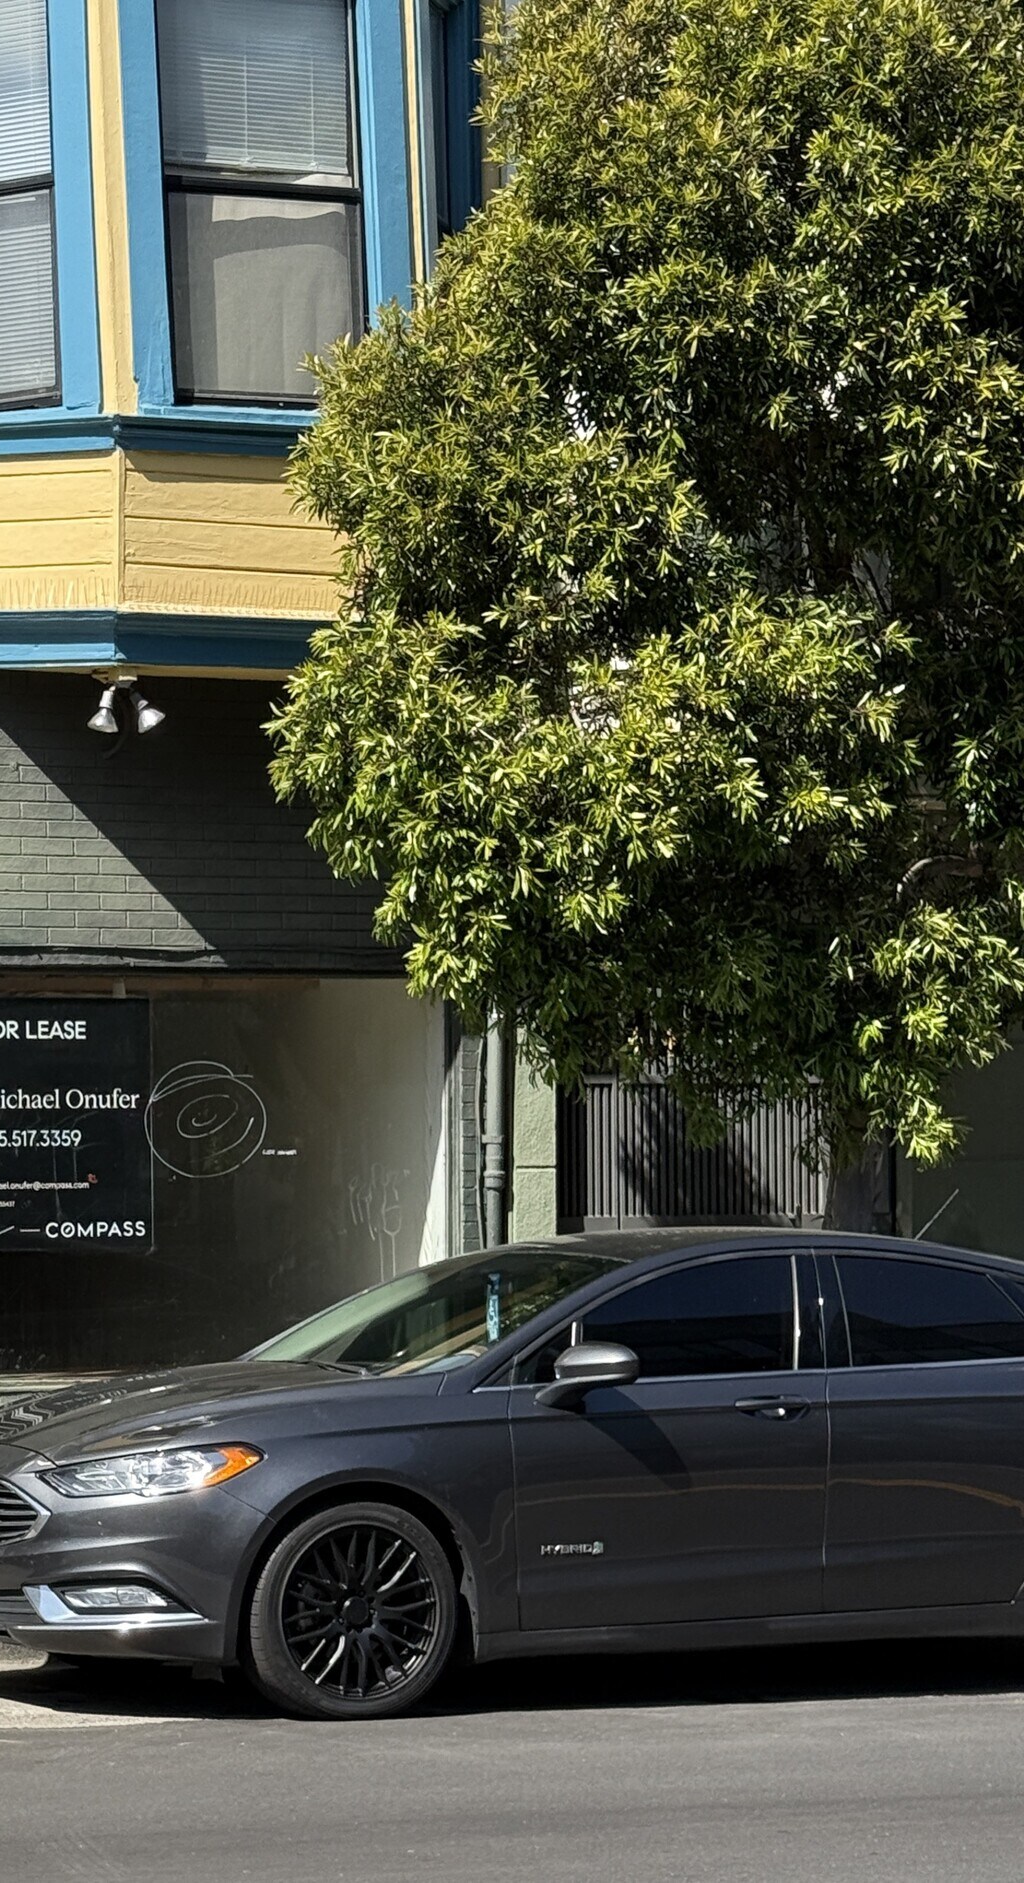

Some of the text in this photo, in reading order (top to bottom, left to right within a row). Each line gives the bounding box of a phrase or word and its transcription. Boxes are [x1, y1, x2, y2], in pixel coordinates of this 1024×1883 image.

[26, 1020, 87, 1040] LEASE
[65, 1087, 140, 1109] Onufer
[45, 1220, 146, 1238] COMPASS
